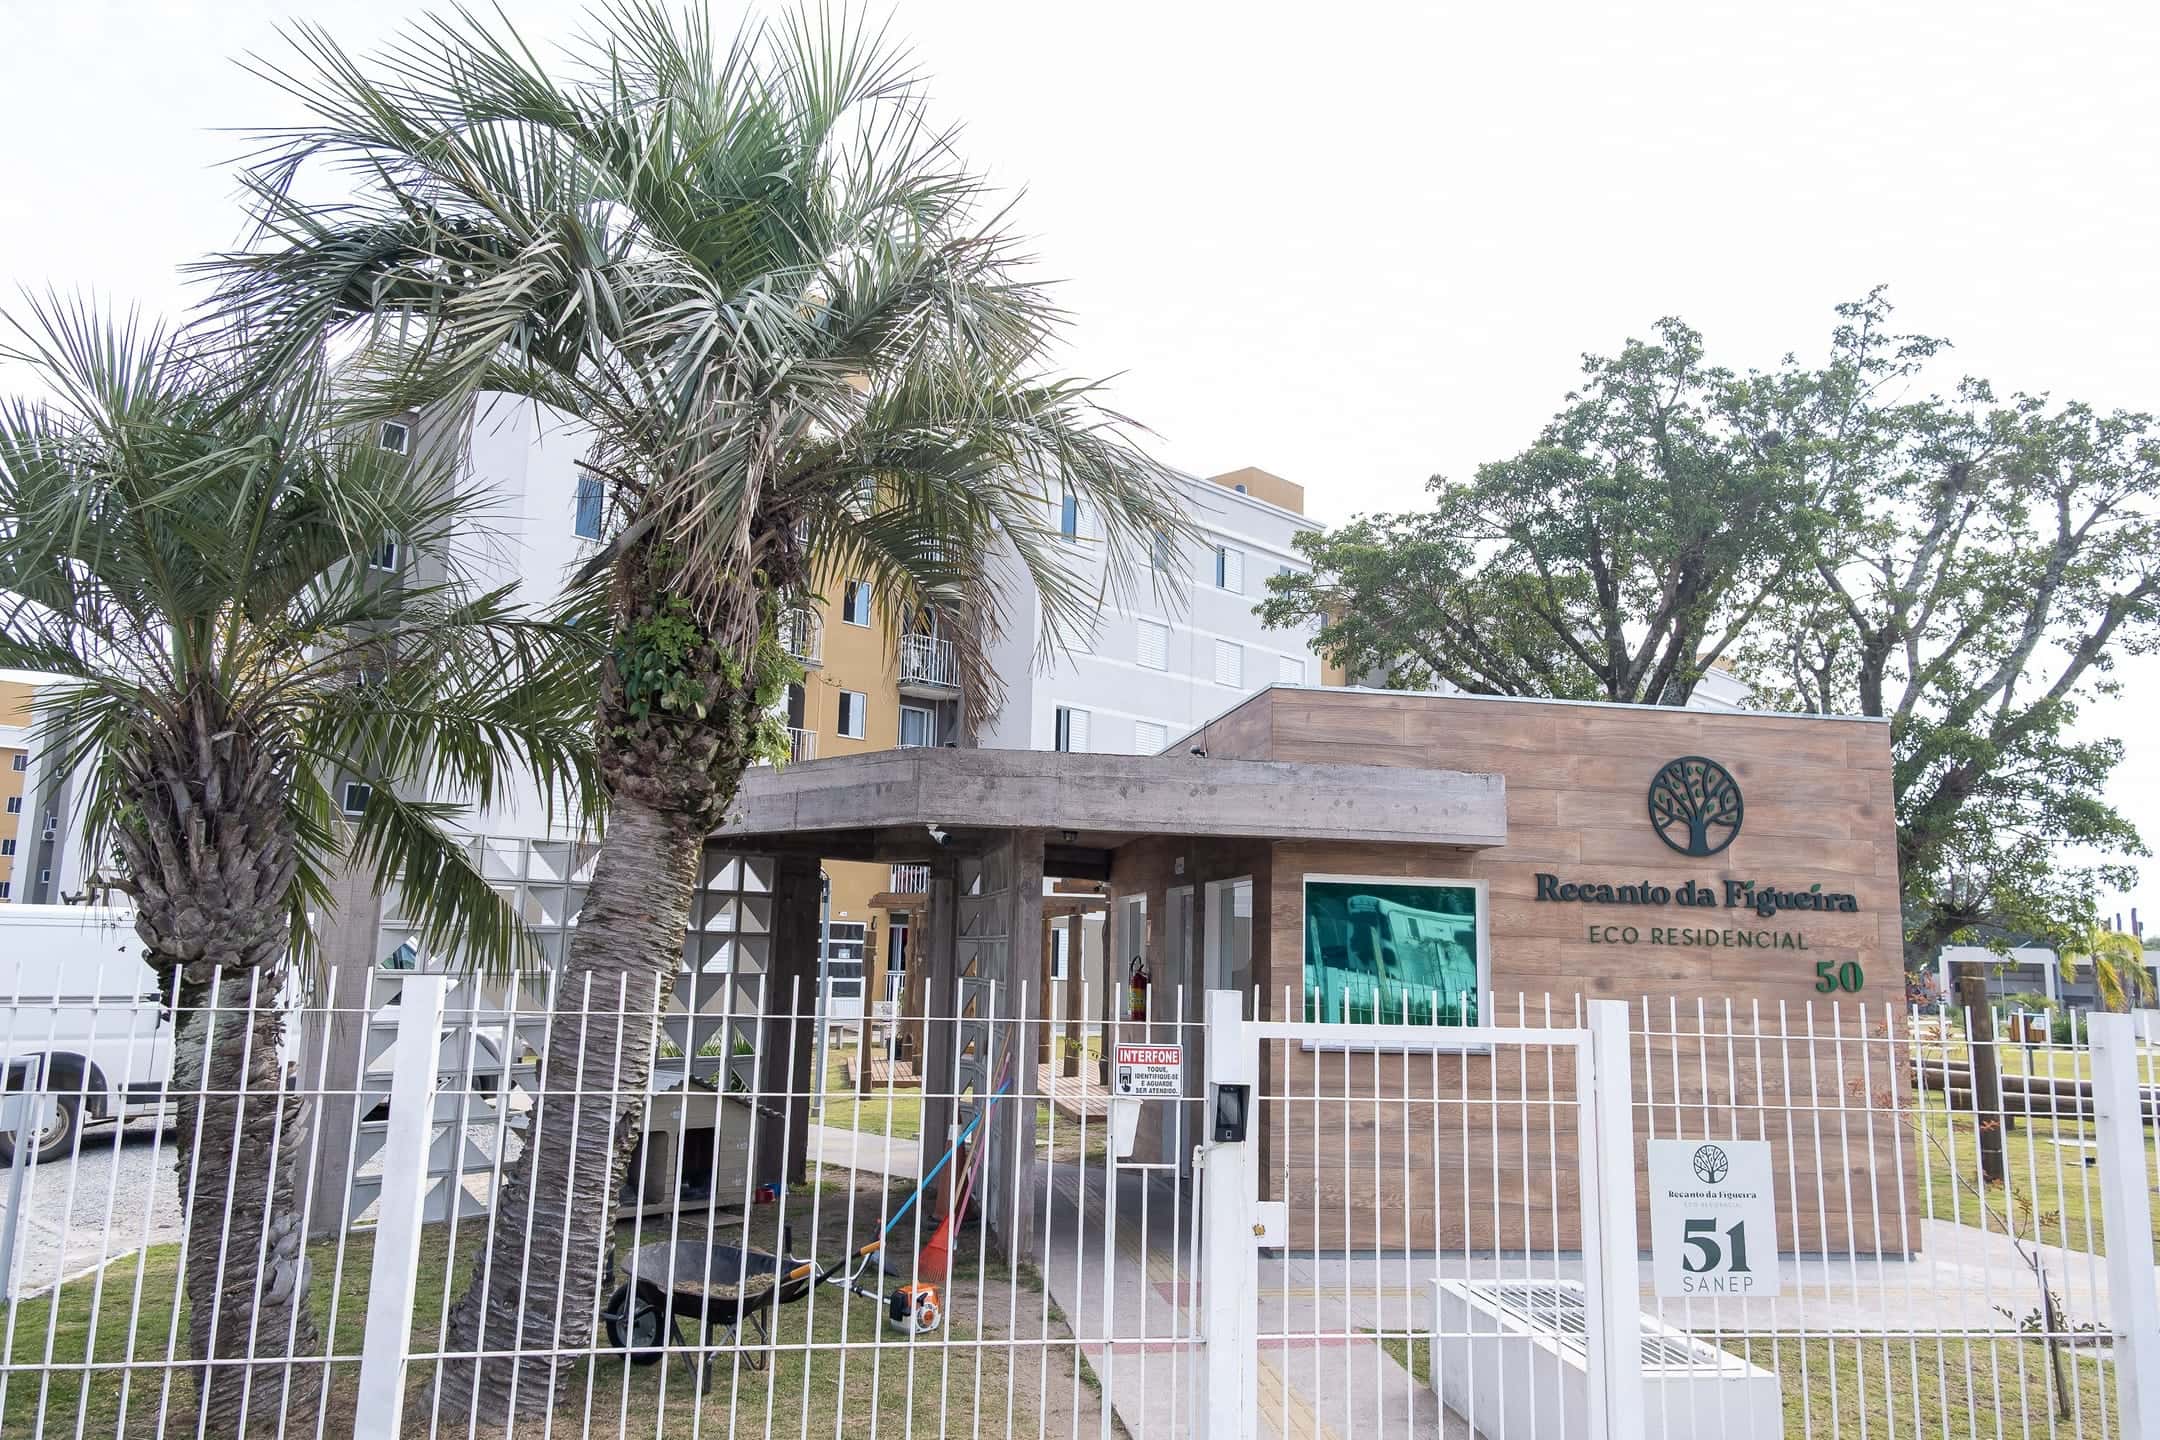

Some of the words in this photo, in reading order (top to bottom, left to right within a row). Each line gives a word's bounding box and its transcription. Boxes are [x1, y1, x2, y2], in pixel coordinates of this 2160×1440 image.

[1535, 873, 1671, 906] Recanto
[1675, 879, 1717, 908] da
[1723, 879, 1858, 918] Figueira
[1589, 926, 1639, 945] ECO
[1651, 929, 1809, 951] RESIDENCIAL
[1815, 960, 1864, 993] 50
[1120, 1049, 1179, 1064] INTERFONE
[1668, 1190, 1705, 1199] Recanto
[1706, 1190, 1717, 1199] da
[1682, 1217, 1752, 1273] 51
[1683, 1276, 1753, 1293] SANEP
